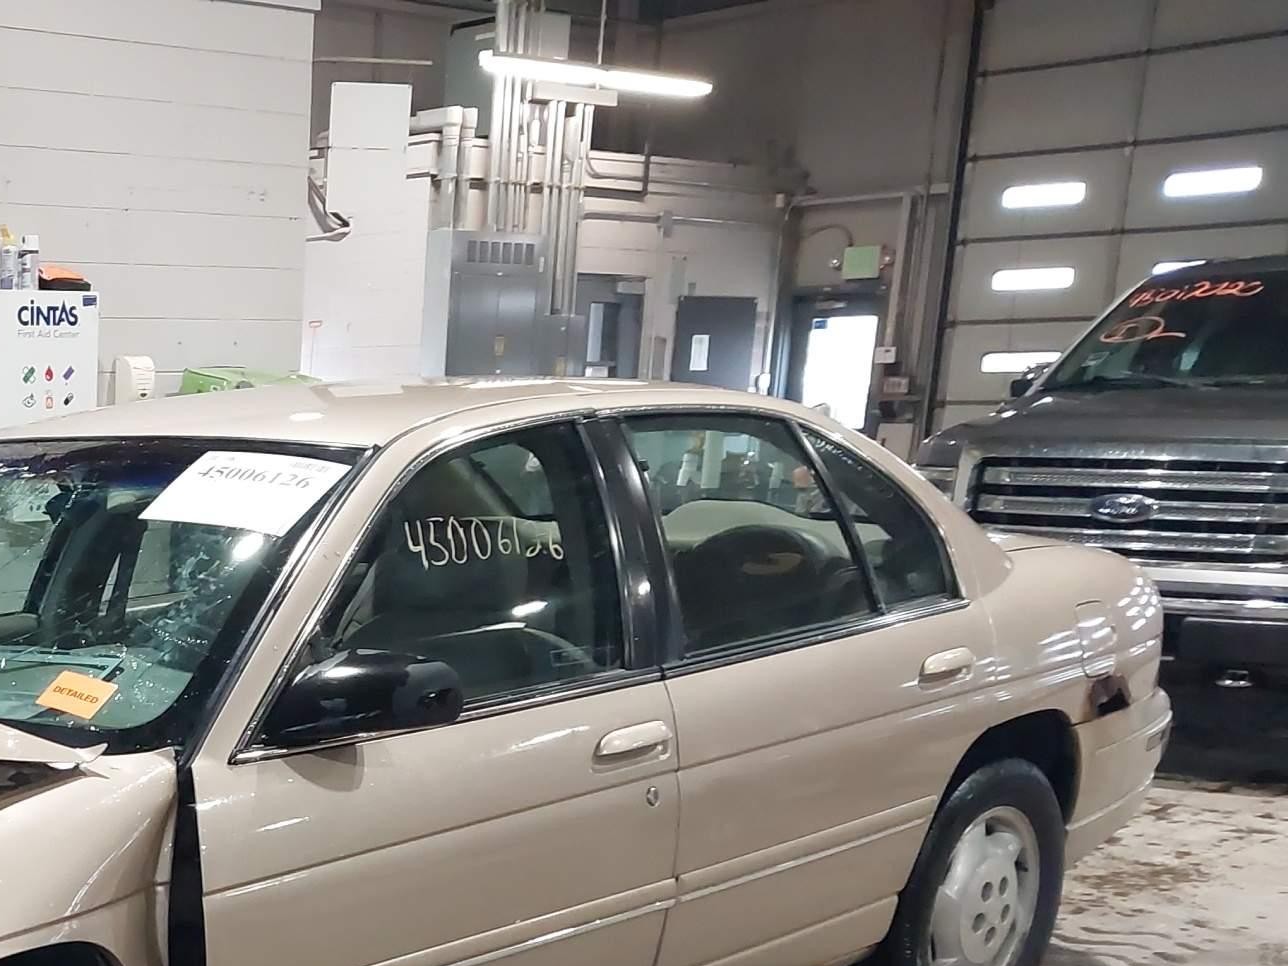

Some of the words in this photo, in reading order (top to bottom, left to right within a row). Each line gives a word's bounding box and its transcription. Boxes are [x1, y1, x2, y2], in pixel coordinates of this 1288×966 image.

[17, 329, 34, 338] First
[37, 329, 51, 338] Aid
[198, 465, 313, 489] 45006126
[53, 686, 99, 705] DETAILED
